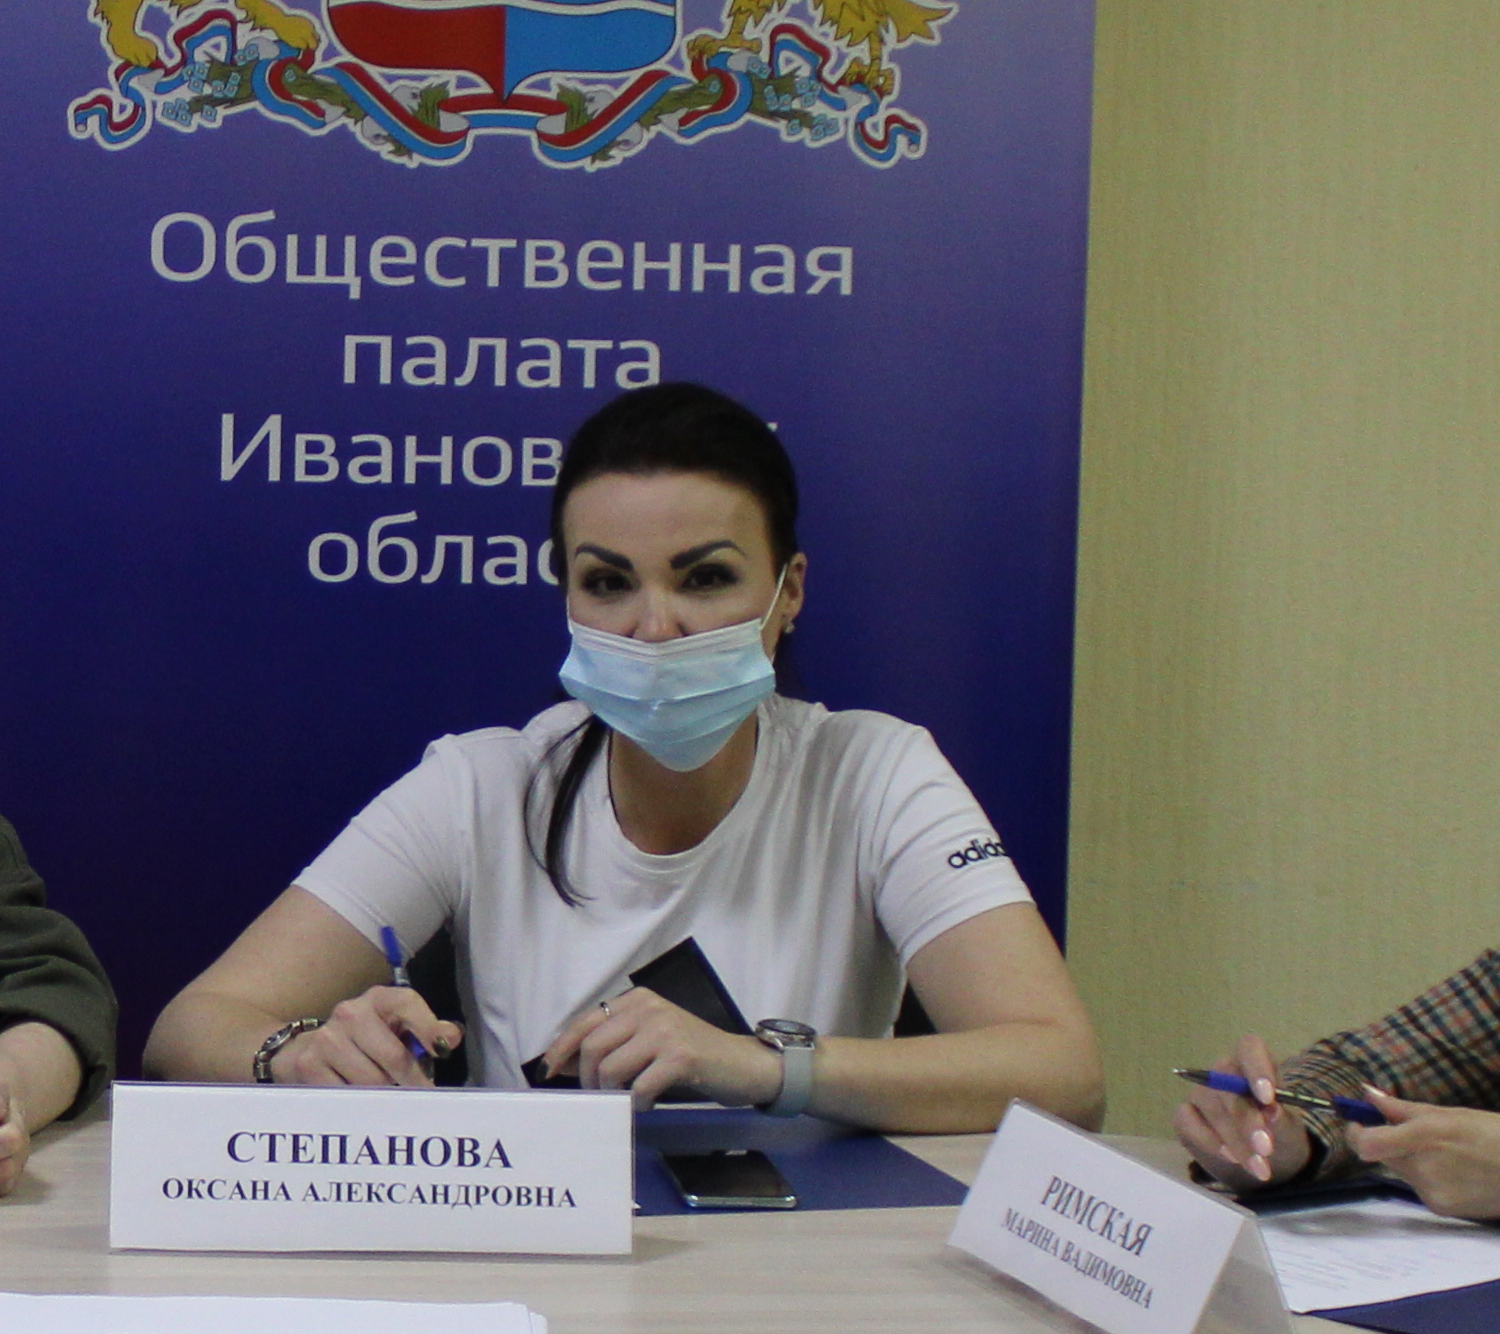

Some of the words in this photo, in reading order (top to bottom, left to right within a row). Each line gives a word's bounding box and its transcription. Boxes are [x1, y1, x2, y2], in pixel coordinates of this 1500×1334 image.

[150, 210, 855, 299] Общественная
[342, 334, 661, 391] палата
[218, 413, 778, 487] Иванов
[306, 510, 567, 585] облас
[226, 1130, 513, 1169] СТЕПАНОВА
[161, 1177, 292, 1202] ОКСАНА
[301, 1182, 577, 1210] АЛЕКСАНДРОВНА
[1040, 1175, 1154, 1258] РИМСКАЯ
[1002, 1208, 1060, 1255] МАРИНА
[1060, 1240, 1155, 1310] ВАДИМОВНА
